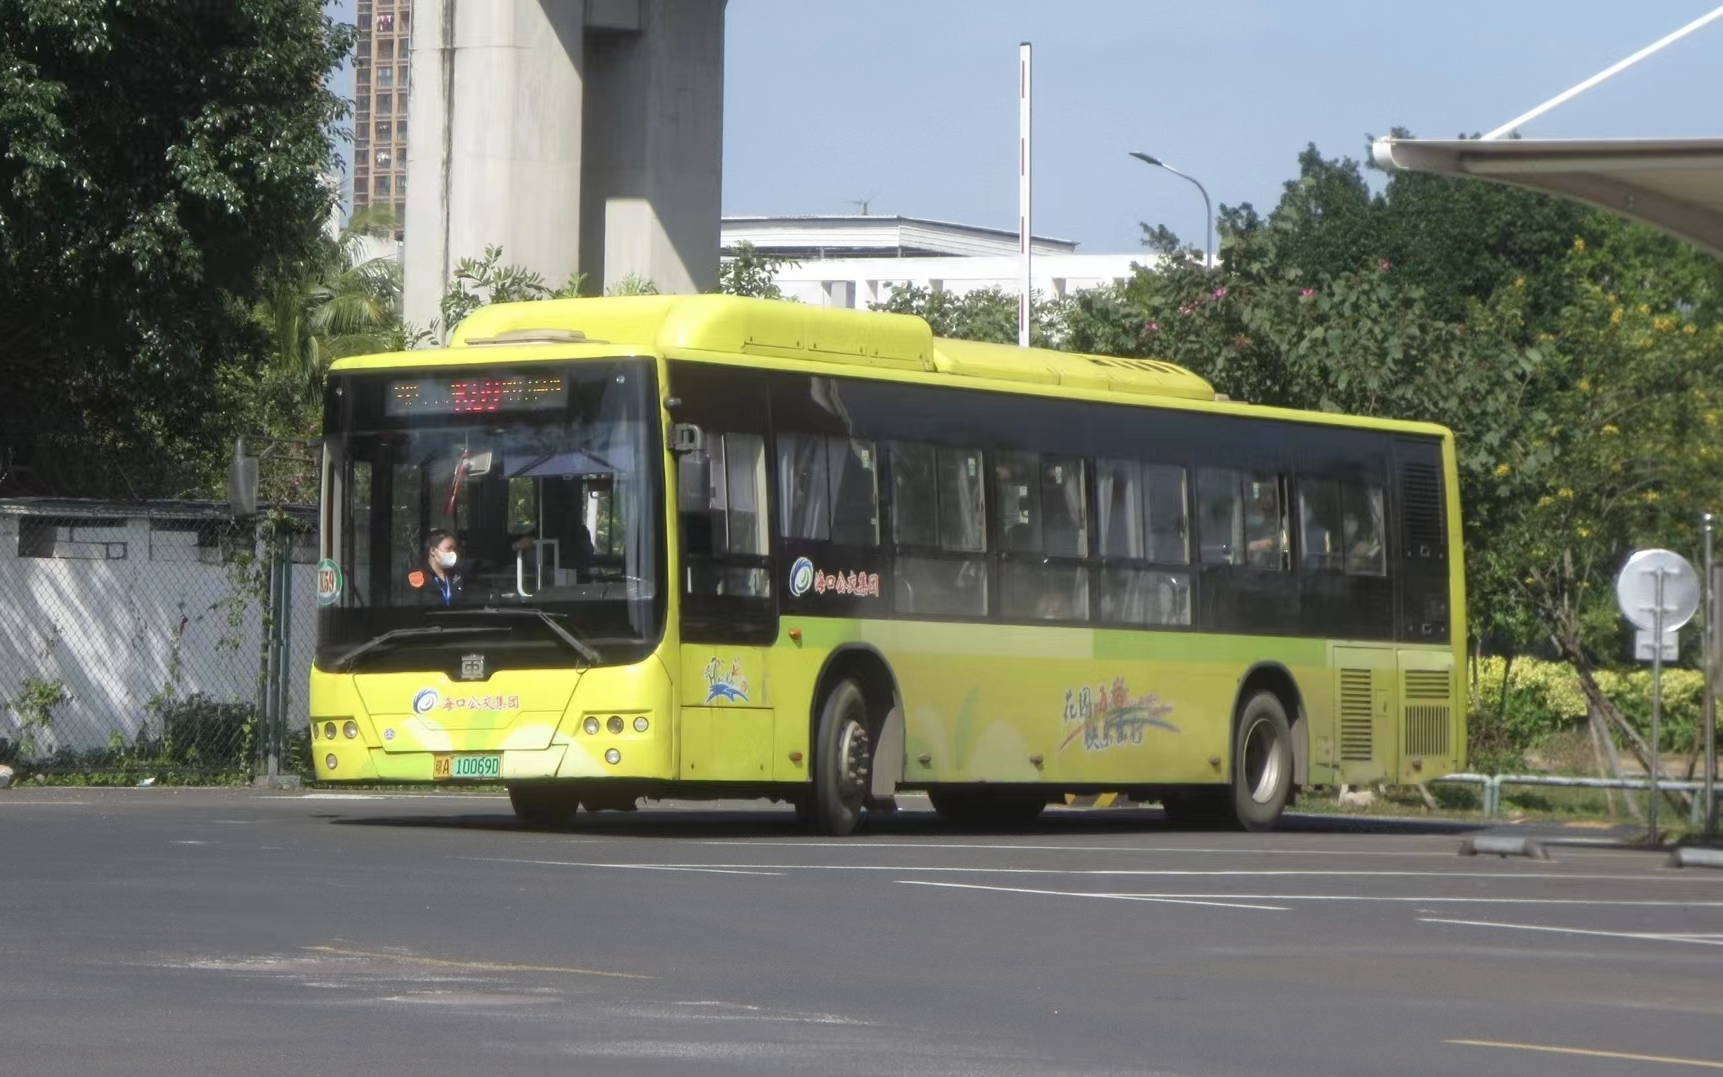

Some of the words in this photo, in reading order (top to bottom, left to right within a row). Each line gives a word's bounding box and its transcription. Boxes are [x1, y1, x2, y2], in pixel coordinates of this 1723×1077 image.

[814, 568, 880, 597] 海口公交集团
[442, 695, 519, 711] 海口公交集团
